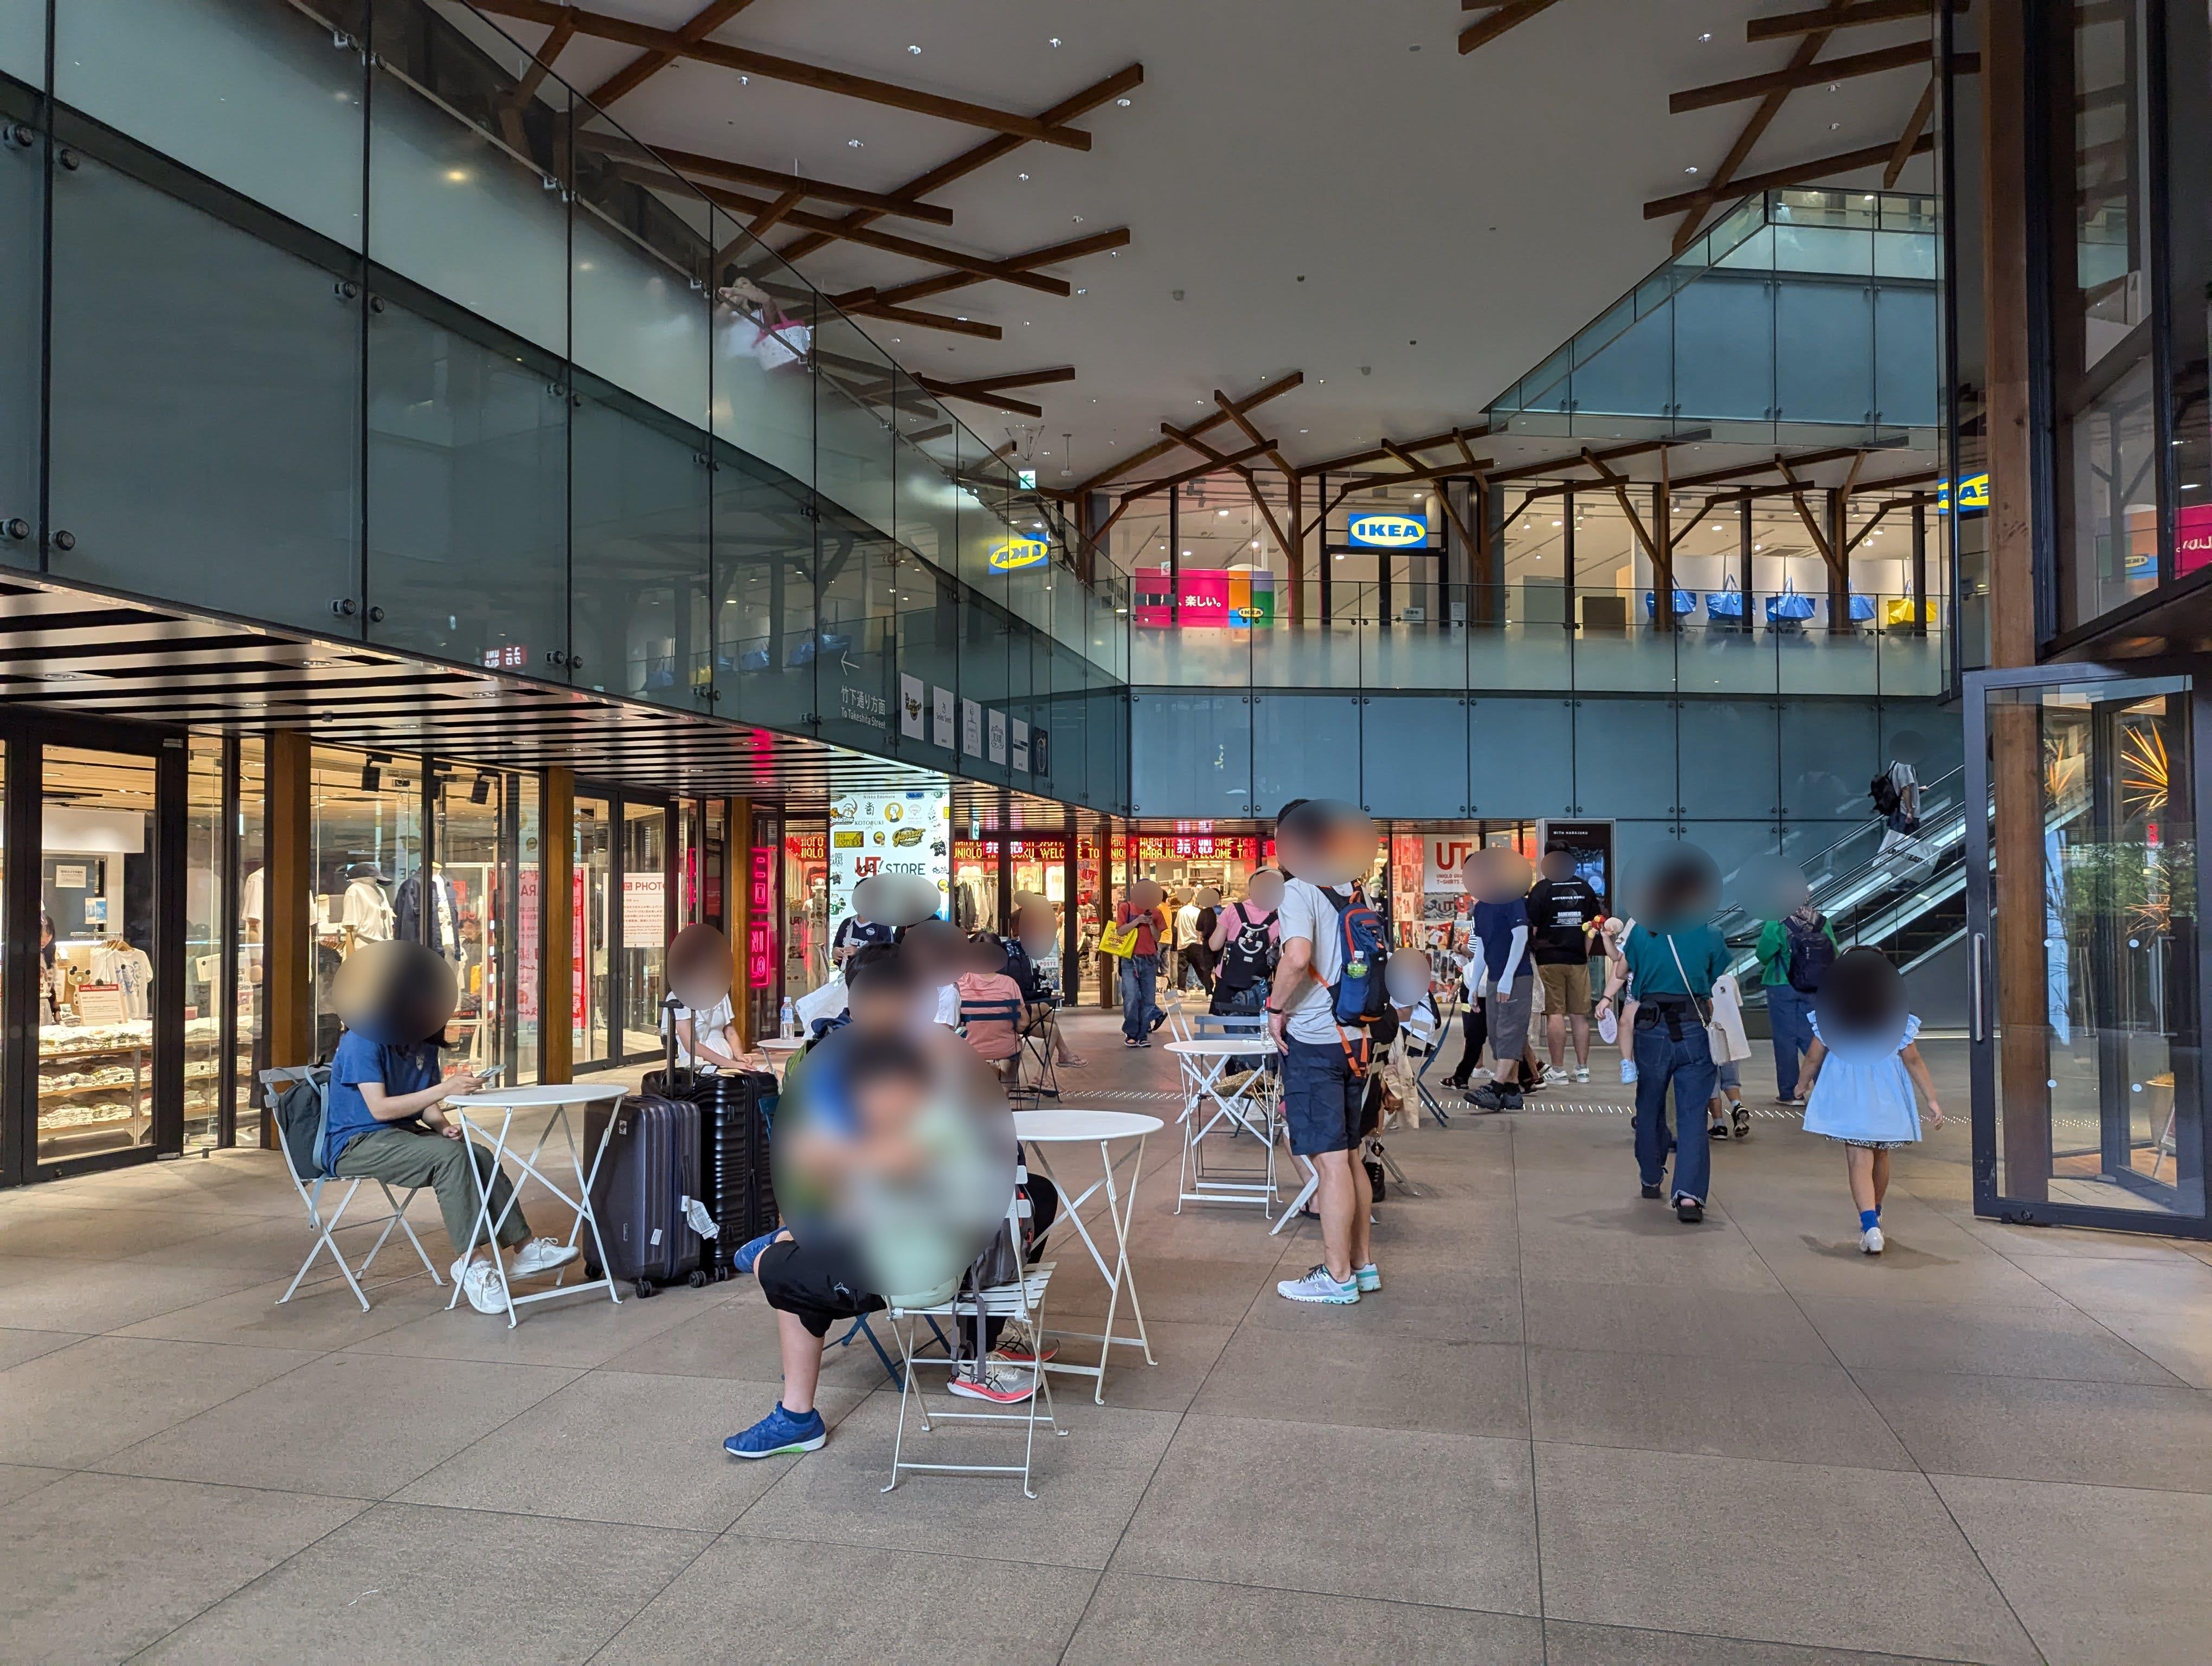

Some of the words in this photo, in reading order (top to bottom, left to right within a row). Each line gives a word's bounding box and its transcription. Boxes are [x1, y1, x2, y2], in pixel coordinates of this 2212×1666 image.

[1358, 524, 1419, 537] IKEA
[841, 685, 885, 716] 竹下通り方面
[841, 707, 847, 718] To
[847, 708, 871, 725] Takeshita
[871, 716, 885, 729] Street
[1436, 842, 1472, 870] UT
[885, 863, 925, 875] STORE
